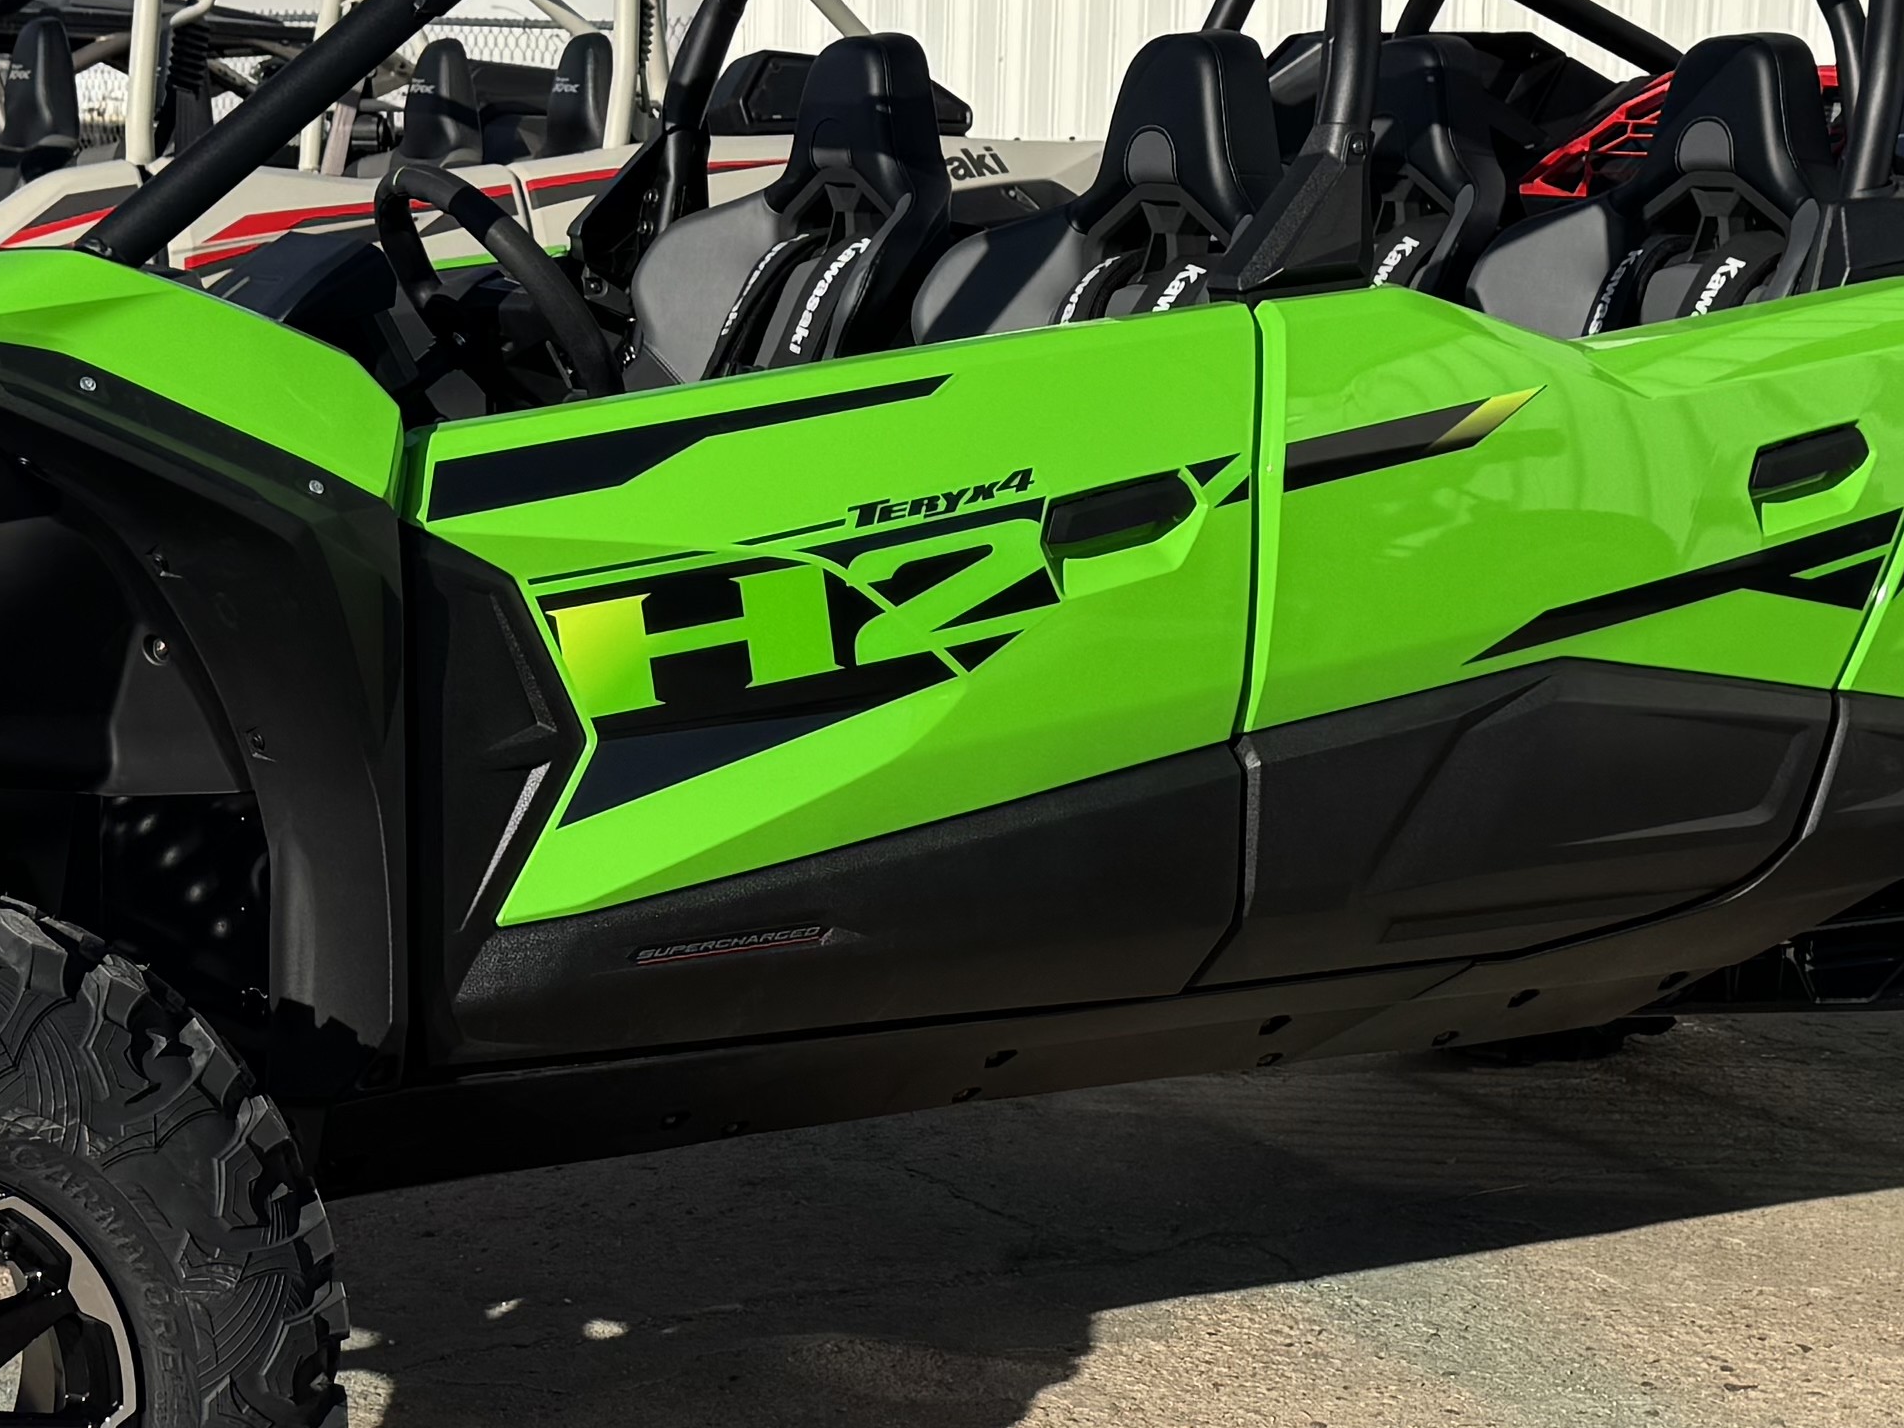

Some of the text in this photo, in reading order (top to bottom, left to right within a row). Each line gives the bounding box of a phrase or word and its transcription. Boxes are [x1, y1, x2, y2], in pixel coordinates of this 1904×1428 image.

[1369, 236, 1420, 289] Kaw
[1691, 256, 1746, 318] Kaw
[789, 237, 871, 355] Kawasaki
[547, 516, 1061, 718] H2
[636, 926, 821, 960] SUPERCHARGED
